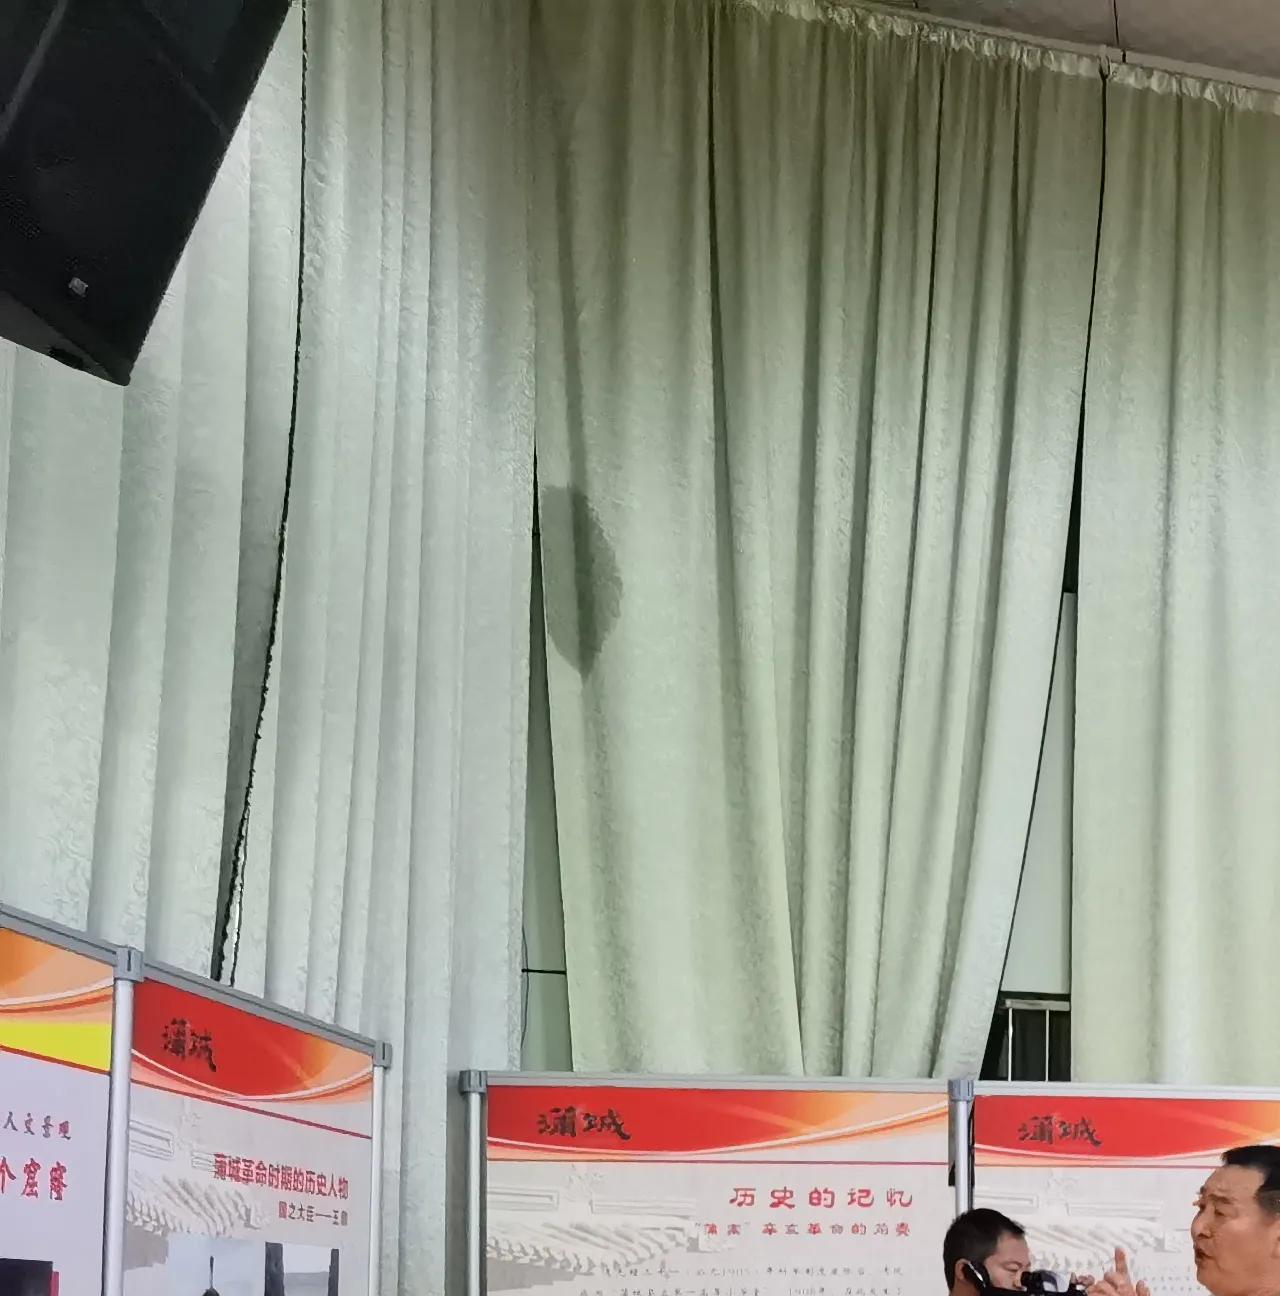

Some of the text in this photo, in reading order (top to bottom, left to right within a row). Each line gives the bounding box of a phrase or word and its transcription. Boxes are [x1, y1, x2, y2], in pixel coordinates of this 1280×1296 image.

[538, 1106, 632, 1141] 蒲城
[1018, 1116, 1102, 1146] 蒲城
[213, 1152, 349, 1200] 蒲城革命时期的历史人物
[729, 1186, 913, 1209] 历史的记忆
